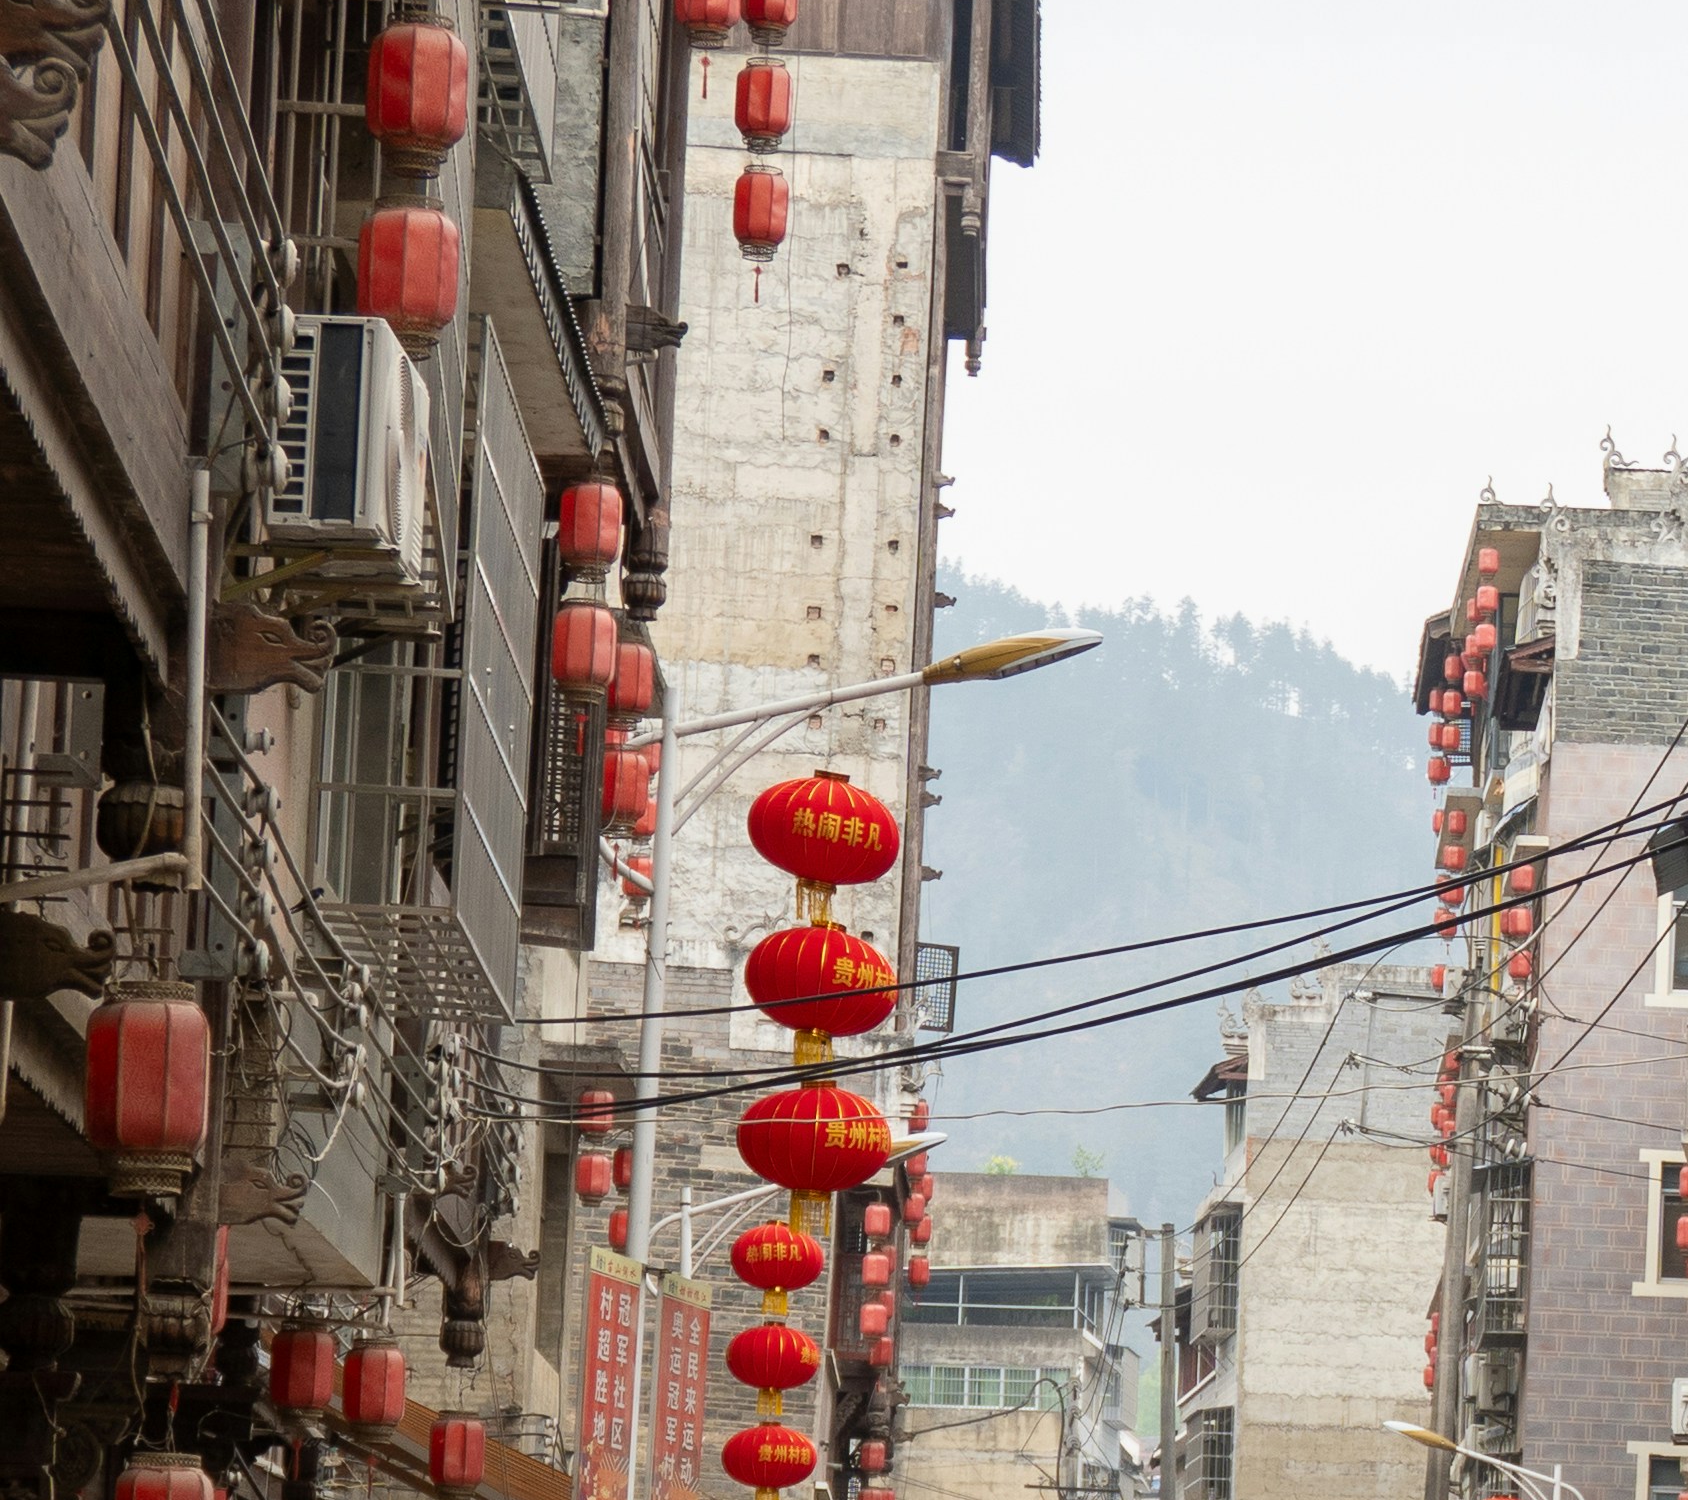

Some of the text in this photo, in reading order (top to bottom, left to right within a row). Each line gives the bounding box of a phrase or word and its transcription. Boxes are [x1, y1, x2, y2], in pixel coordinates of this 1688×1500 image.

[791, 806, 883, 851] 热闹非凡
[746, 1243, 803, 1264] 热闹非凡
[593, 1286, 613, 1445] 村超胜地
[611, 1293, 631, 1450] 冠军社区
[661, 1310, 684, 1481] 奥运冠军村
[680, 1317, 701, 1483] 全民来运动
